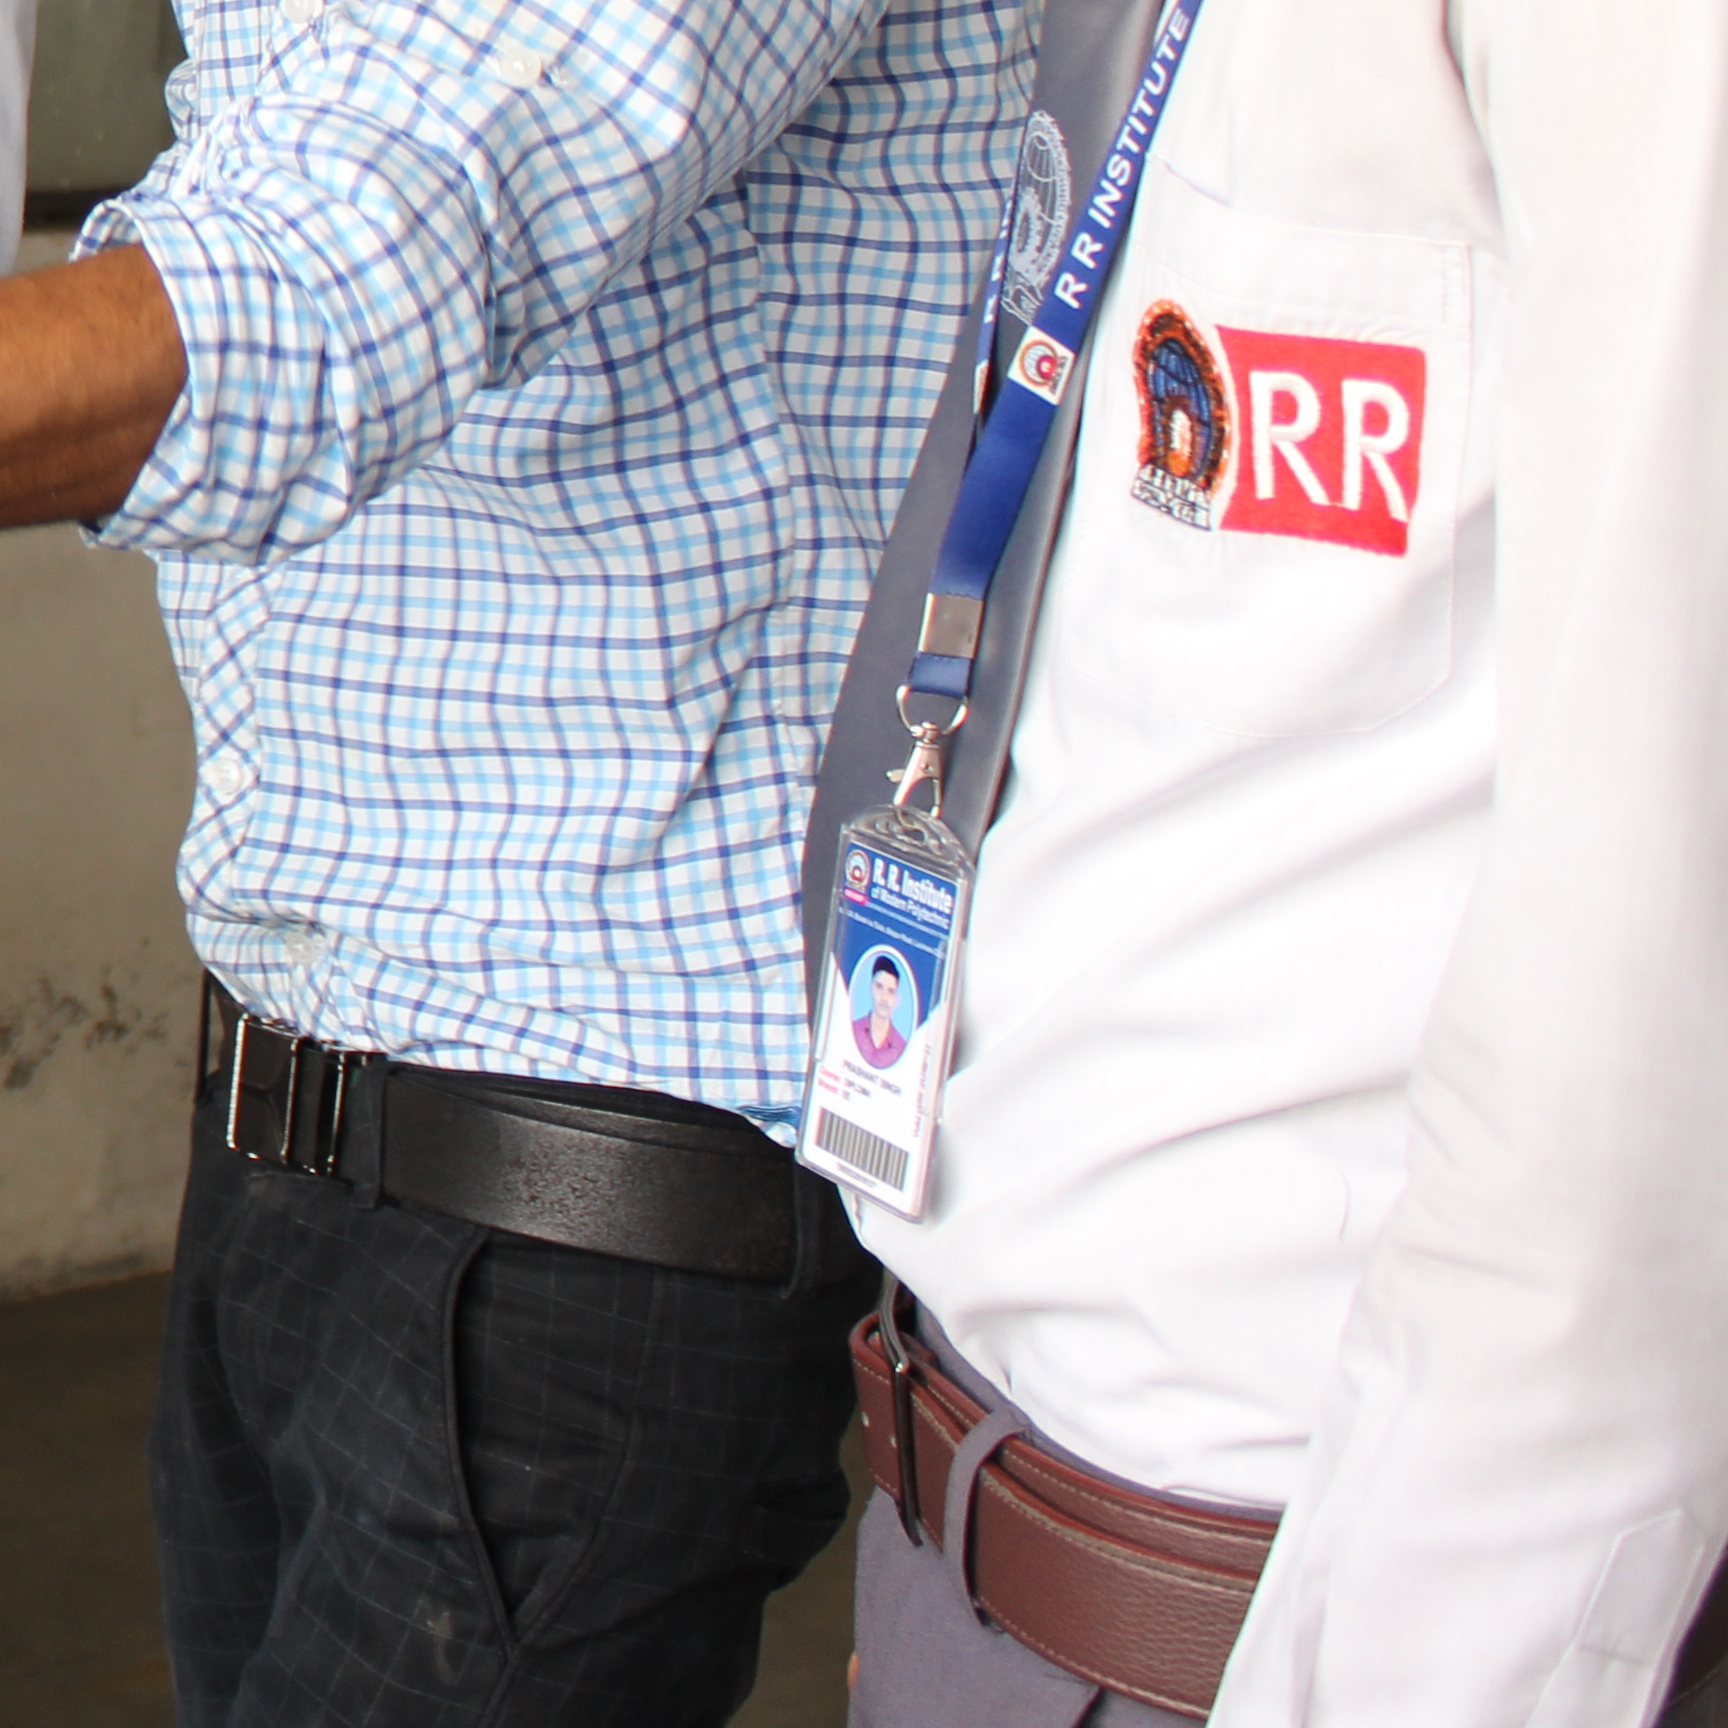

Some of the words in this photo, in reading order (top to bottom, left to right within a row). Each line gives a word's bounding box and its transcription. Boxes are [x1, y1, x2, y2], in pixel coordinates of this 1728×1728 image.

[1088, 8, 1190, 229] INSTITUTE
[1070, 231, 1106, 270] R
[1053, 272, 1091, 311] R
[1249, 370, 1409, 522] RR
[902, 870, 953, 914] Institute
